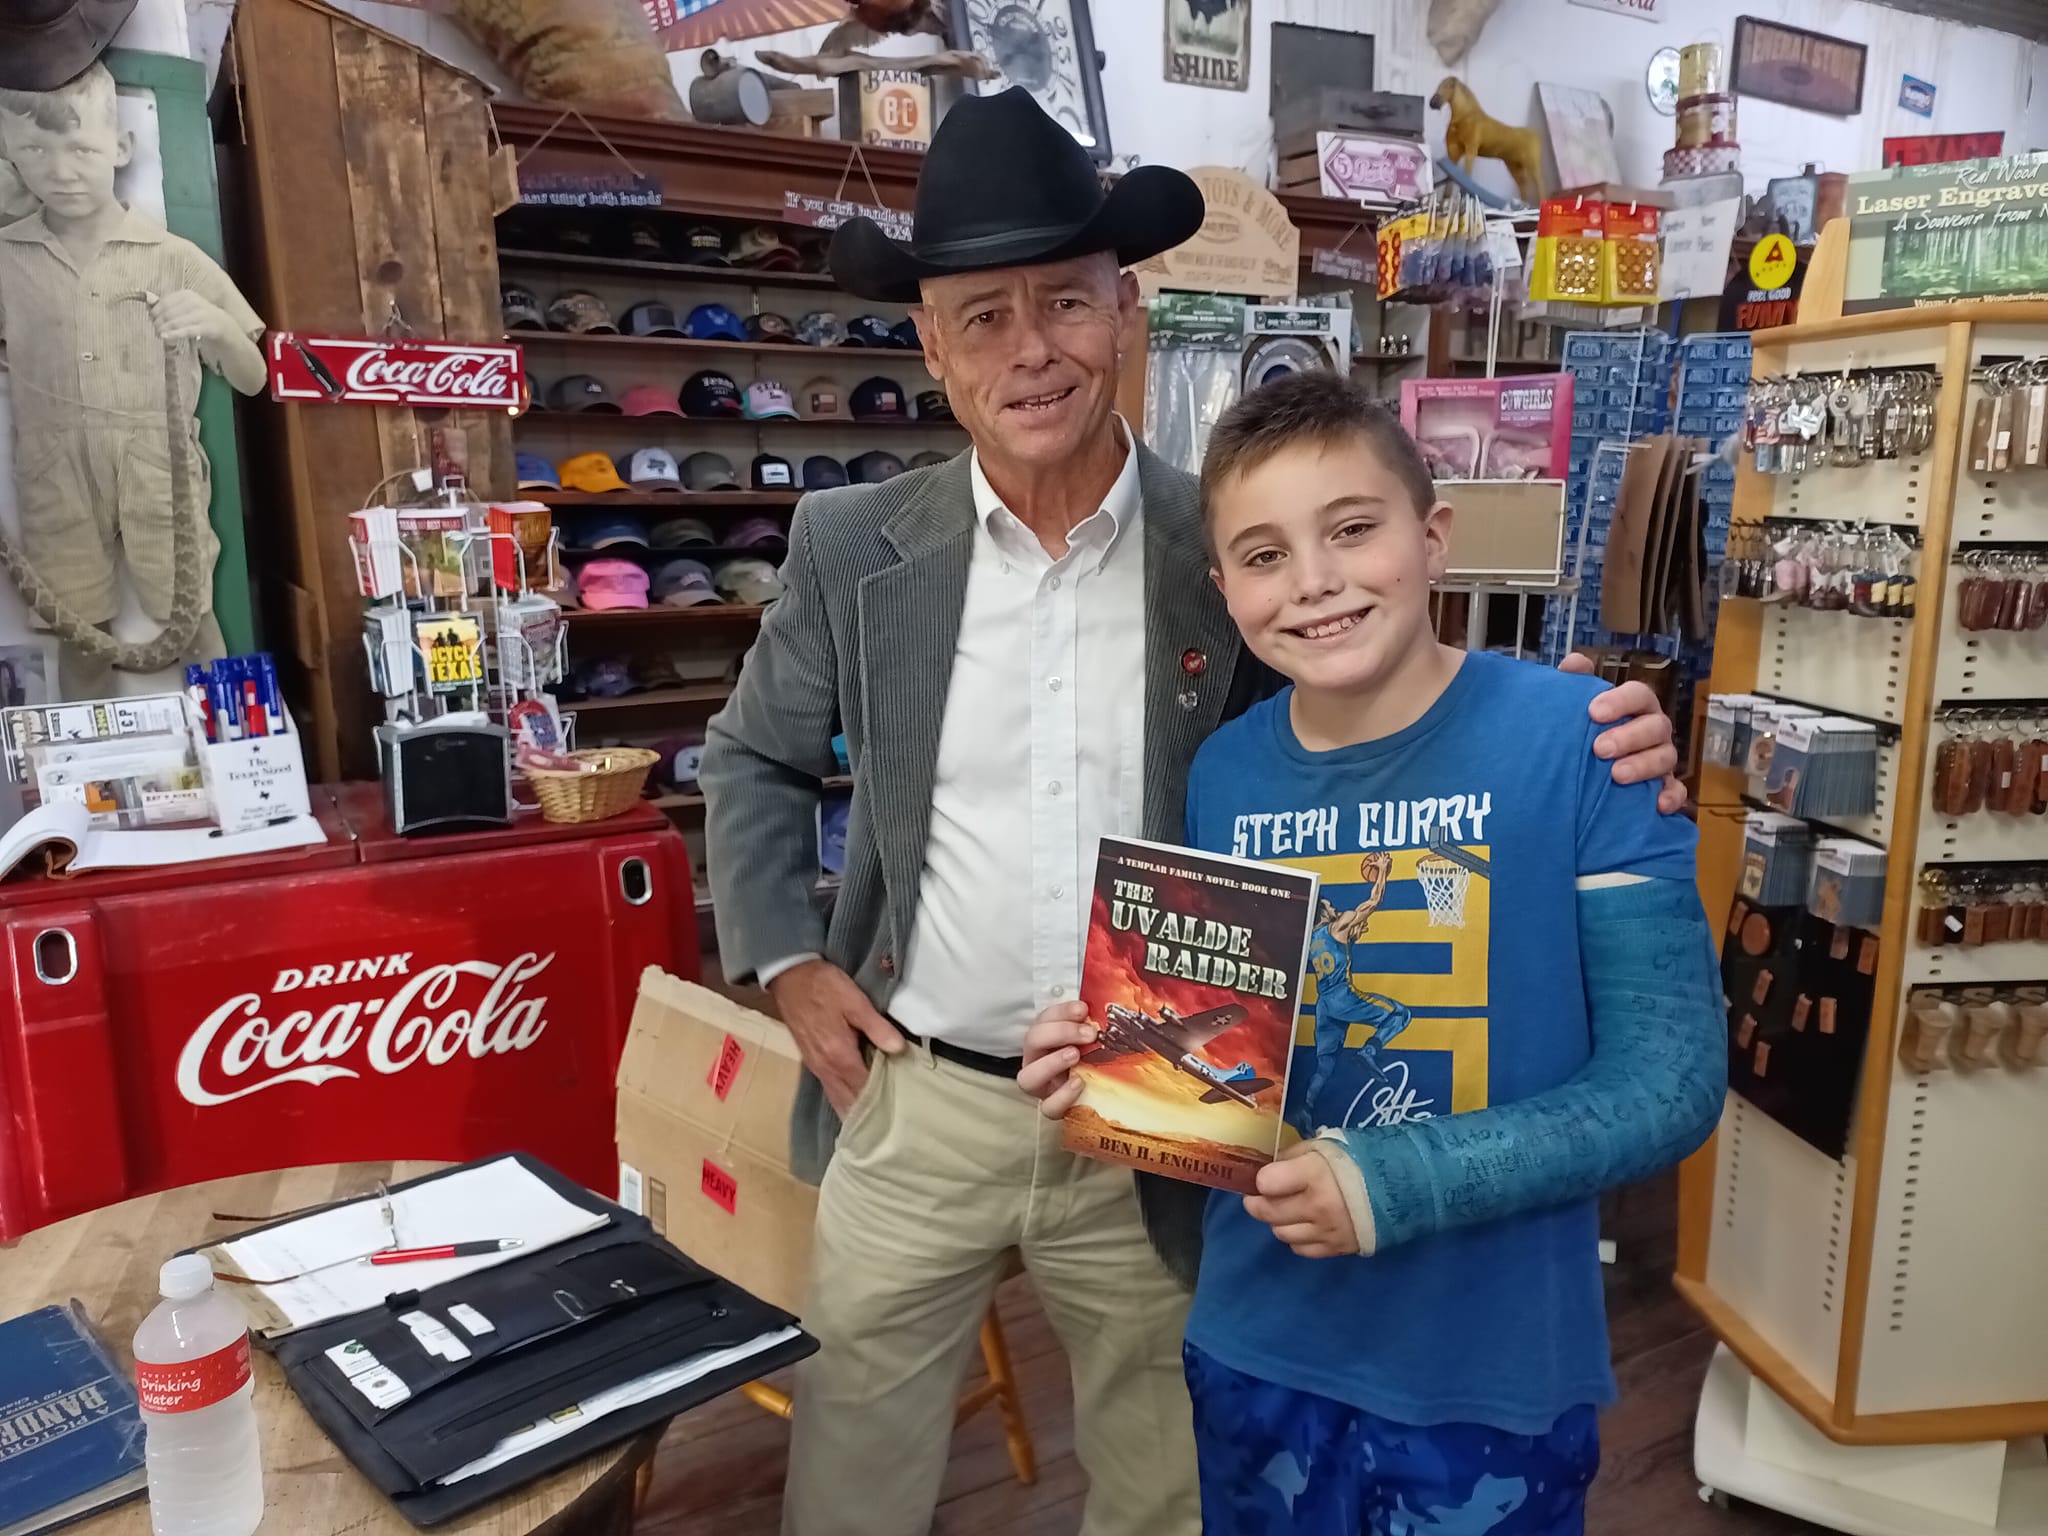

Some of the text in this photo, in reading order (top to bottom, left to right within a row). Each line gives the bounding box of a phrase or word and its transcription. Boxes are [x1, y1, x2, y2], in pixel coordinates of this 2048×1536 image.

[1956, 160, 2042, 191] Real Wood
[589, 191, 618, 206] both
[619, 190, 662, 206] hands
[804, 198, 824, 211] you
[1857, 193, 1932, 215] Laser
[1202, 177, 1241, 207] TOYS
[1256, 202, 1294, 253] MORE
[1893, 212, 1908, 232] A
[1914, 208, 1985, 231] Souvenir
[1985, 203, 2033, 240] from
[346, 349, 510, 396] Coca-Cola
[431, 656, 485, 682] TEXAS
[249, 757, 268, 767] The
[262, 764, 292, 776] Sized
[253, 778, 274, 788] Pen
[1231, 792, 1491, 858] STEPH CURRY
[1113, 879, 1155, 903] THE
[1117, 856, 1292, 900] A TEMPLAR FAMILY NOVEL: BOOK ONE
[1111, 900, 1253, 958] UVALDE
[271, 952, 413, 994] DRINK
[1144, 942, 1288, 1000] RAIDER
[175, 952, 557, 1106] Coca-Cola
[714, 1039, 742, 1096] HEAVY
[1100, 1135, 1234, 1180] BEN H. ENGLISH
[702, 1167, 736, 1203] HEAVY
[141, 1377, 202, 1392] Drinking
[143, 1391, 183, 1406] Water
[96, 1405, 109, 1415] A
